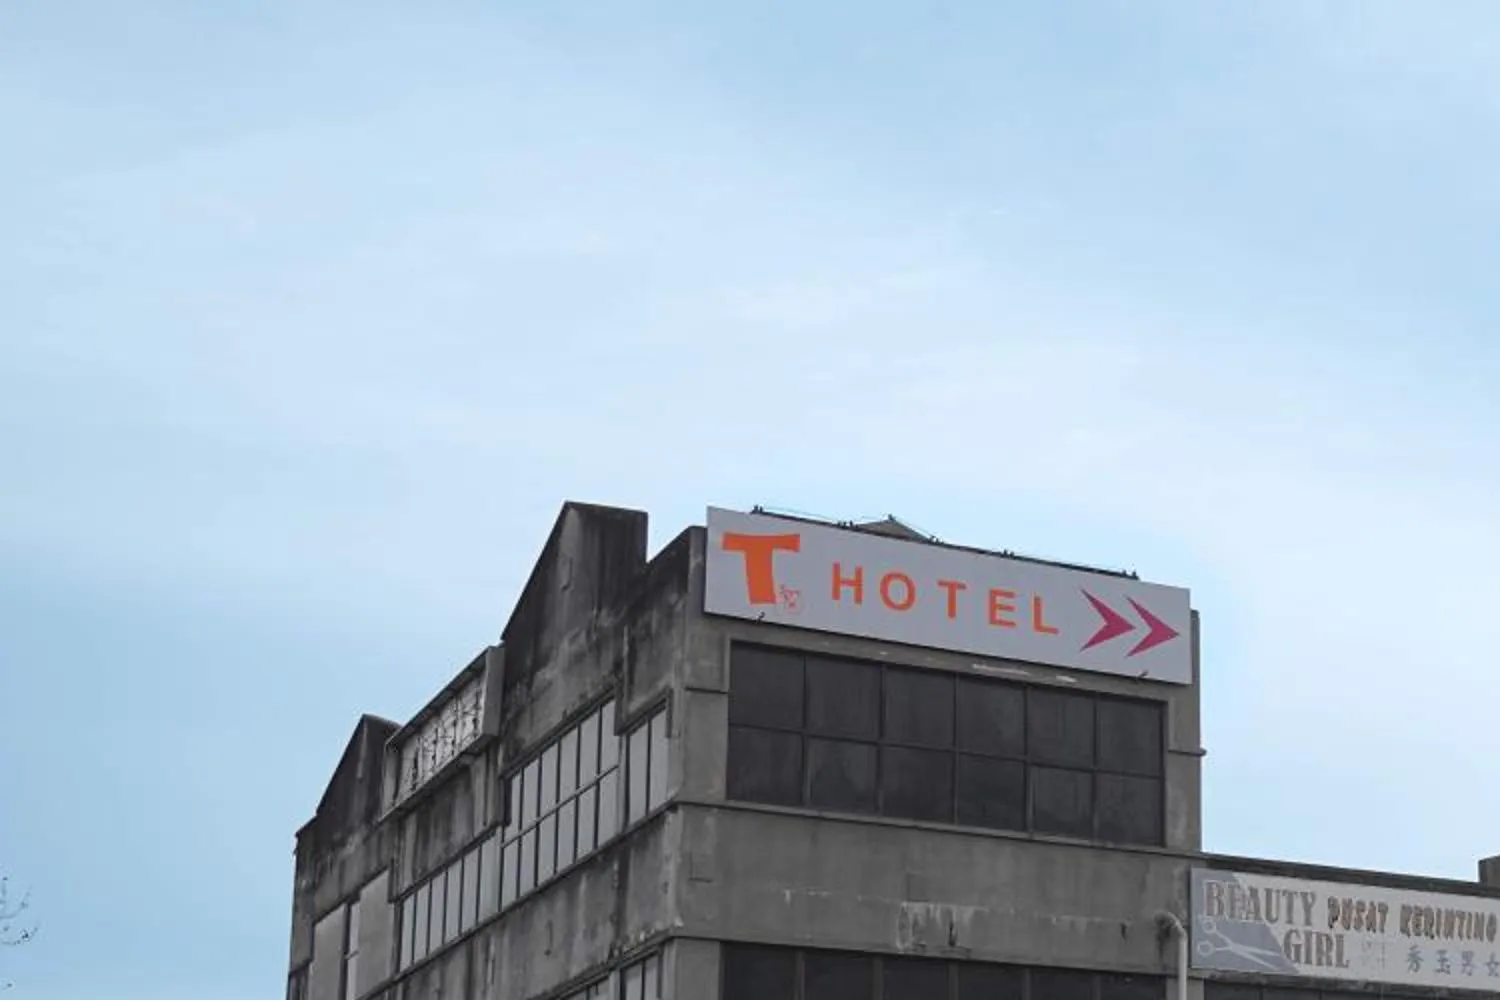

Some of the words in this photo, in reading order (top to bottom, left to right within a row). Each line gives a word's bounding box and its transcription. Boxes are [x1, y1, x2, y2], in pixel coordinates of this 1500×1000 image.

[831, 560, 1060, 635] HOTEL
[1204, 880, 1317, 927] BEAUTY
[1327, 895, 1389, 934] PUSAT
[1400, 904, 1497, 943] KERINTING
[1283, 928, 1350, 968] GIRL
